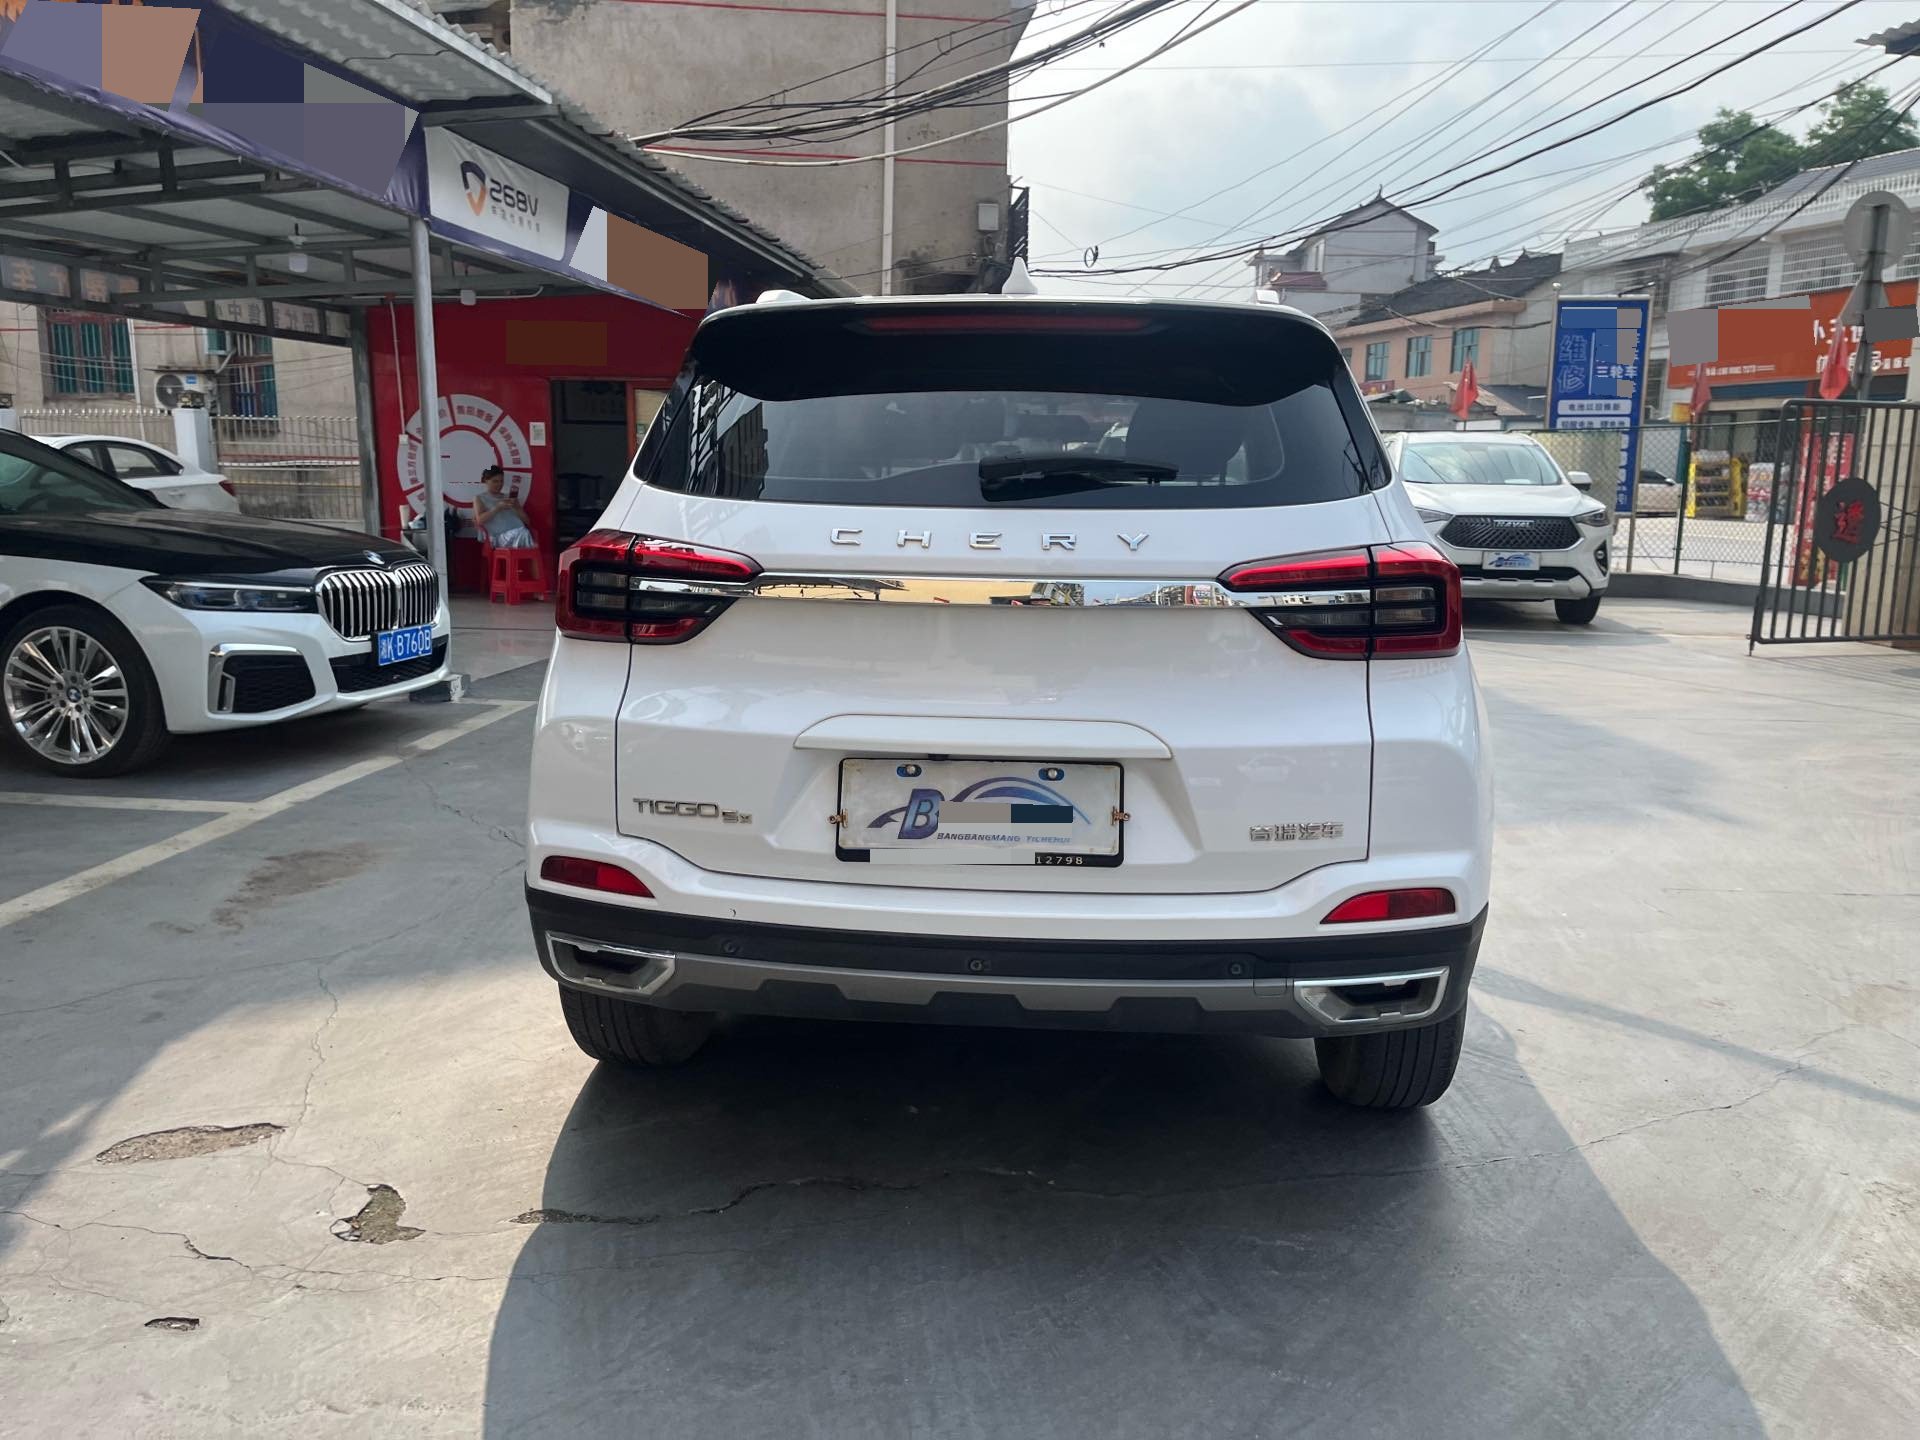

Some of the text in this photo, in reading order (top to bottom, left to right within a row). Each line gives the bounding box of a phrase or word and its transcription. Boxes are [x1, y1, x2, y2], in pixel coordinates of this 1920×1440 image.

[489, 178, 539, 217] 268V
[1595, 365, 1638, 378] 三轮车
[830, 528, 1149, 551] CHERY
[632, 797, 719, 818] TIGGO
[937, 832, 1021, 843] BANGBANGMANG
[1248, 822, 1344, 841] 奇瑞汽车
[1036, 856, 1083, 866] 12798
